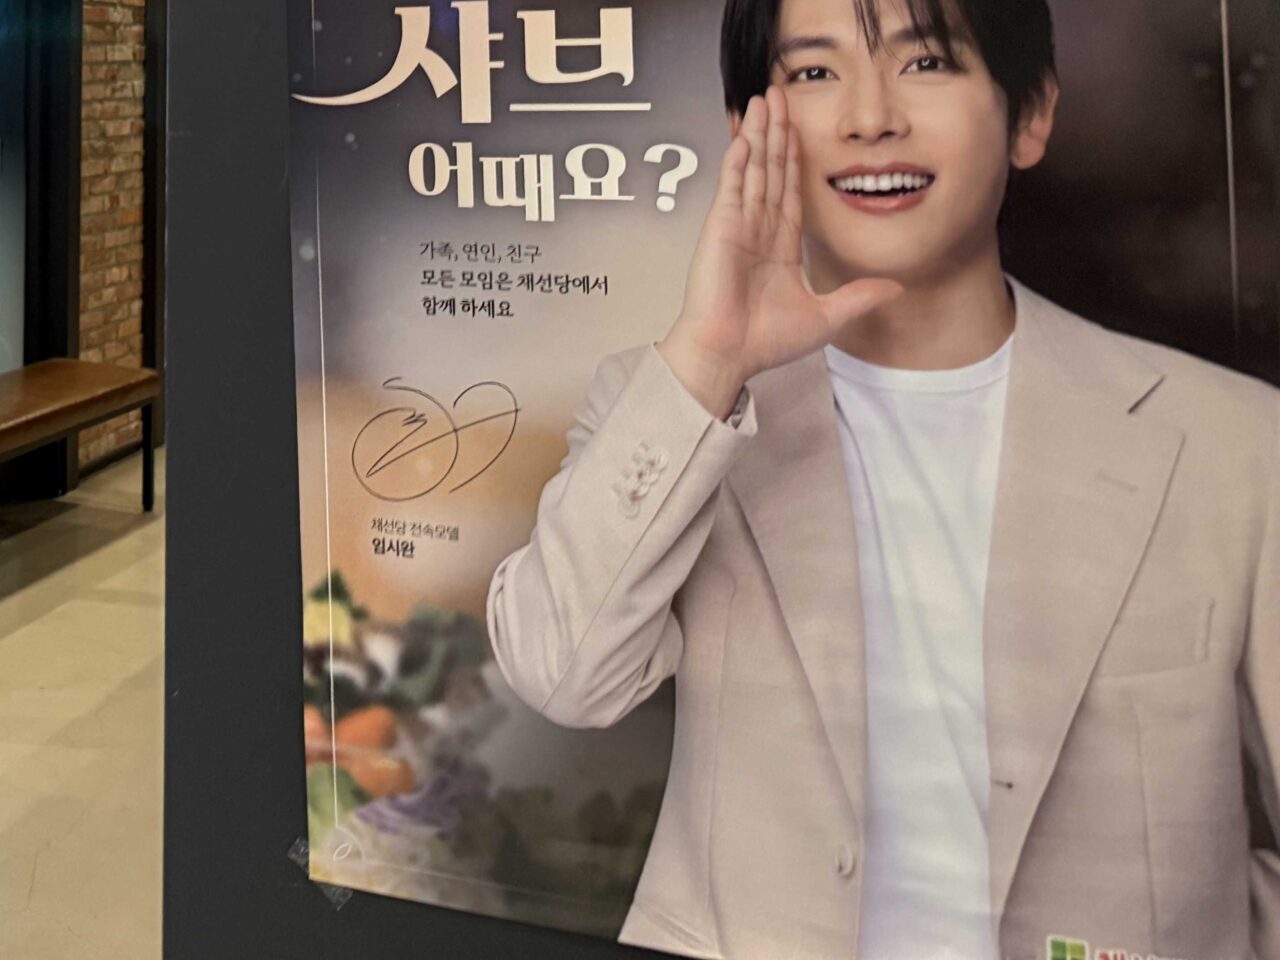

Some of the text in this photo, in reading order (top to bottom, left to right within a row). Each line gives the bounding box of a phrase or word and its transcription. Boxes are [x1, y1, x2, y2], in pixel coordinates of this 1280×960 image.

[291, 0, 651, 124] 샤브
[408, 141, 698, 222] 어때요?
[419, 242, 542, 263] 가족, 연인, 친구
[420, 270, 609, 296] 모든 모임은 채선당에서
[422, 296, 514, 318] 함께 하세요
[372, 538, 415, 558] 임시완
